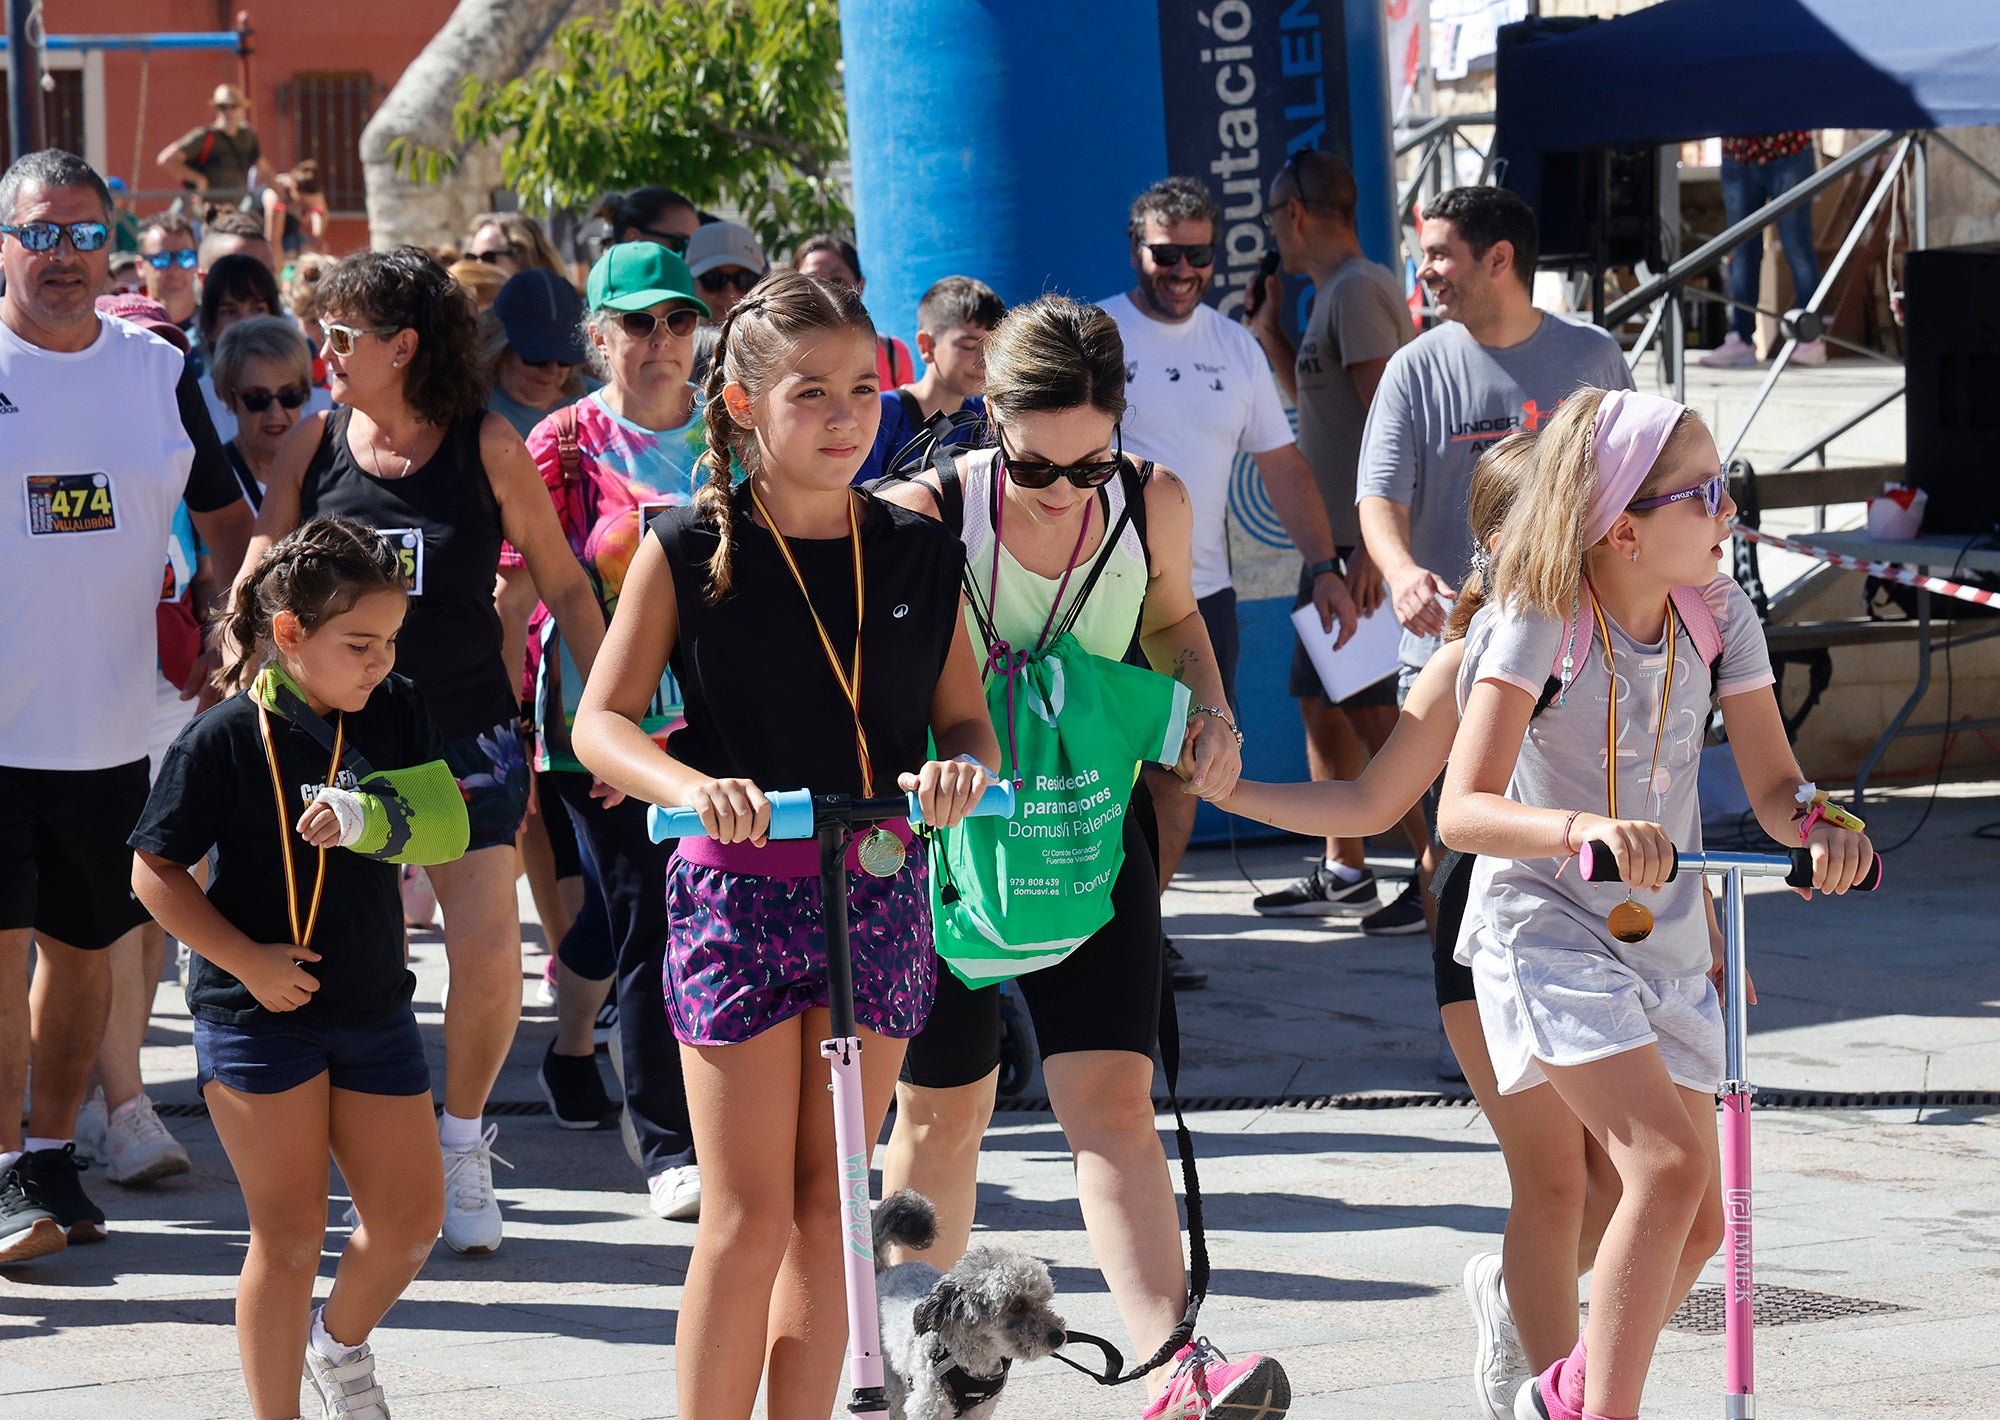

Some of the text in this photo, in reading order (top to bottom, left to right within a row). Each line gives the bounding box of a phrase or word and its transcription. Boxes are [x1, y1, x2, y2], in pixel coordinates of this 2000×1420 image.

[1450, 416, 1520, 436] UNDER
[51, 488, 112, 518] 474
[52, 515, 114, 532] VILLALOBÓN
[1036, 769, 1100, 791] Residecia
[1073, 803, 1123, 837] Palencia
[1009, 878, 1060, 886] 979 808 439
[1013, 887, 1060, 896] domusvi.es
